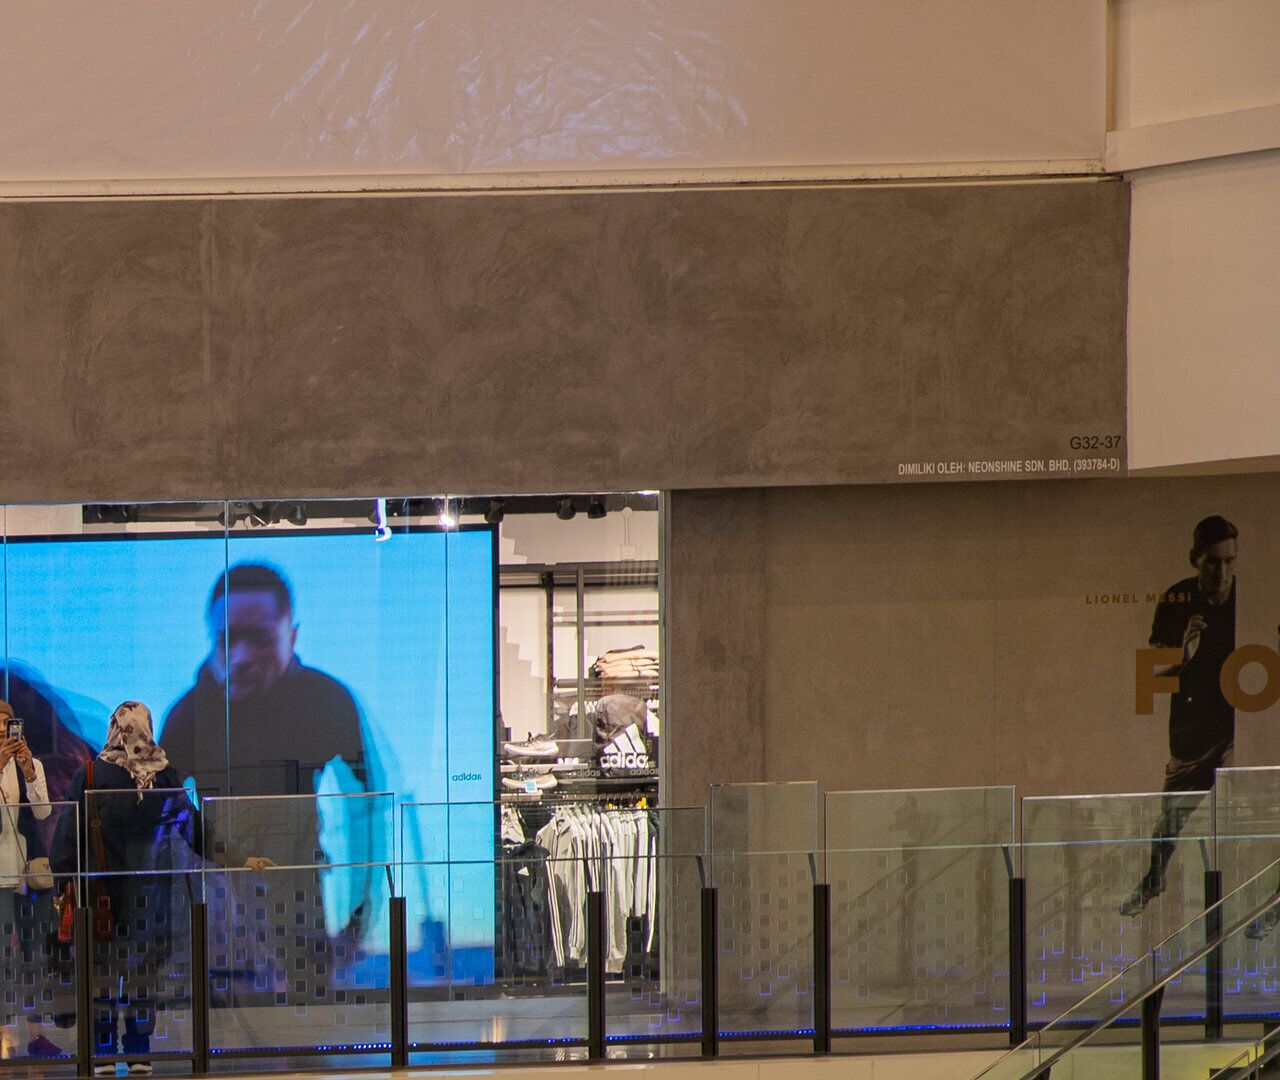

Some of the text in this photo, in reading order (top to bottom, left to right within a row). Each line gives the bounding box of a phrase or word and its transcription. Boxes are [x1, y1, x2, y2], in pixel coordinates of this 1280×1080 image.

[1070, 436, 1122, 450] G32-37
[898, 457, 1121, 476] DIMILIKI OLEH: NEONSHINE SDN. BHD. (393784-D)
[1086, 591, 1191, 605] LIONEL MESSI
[600, 752, 648, 769] adida
